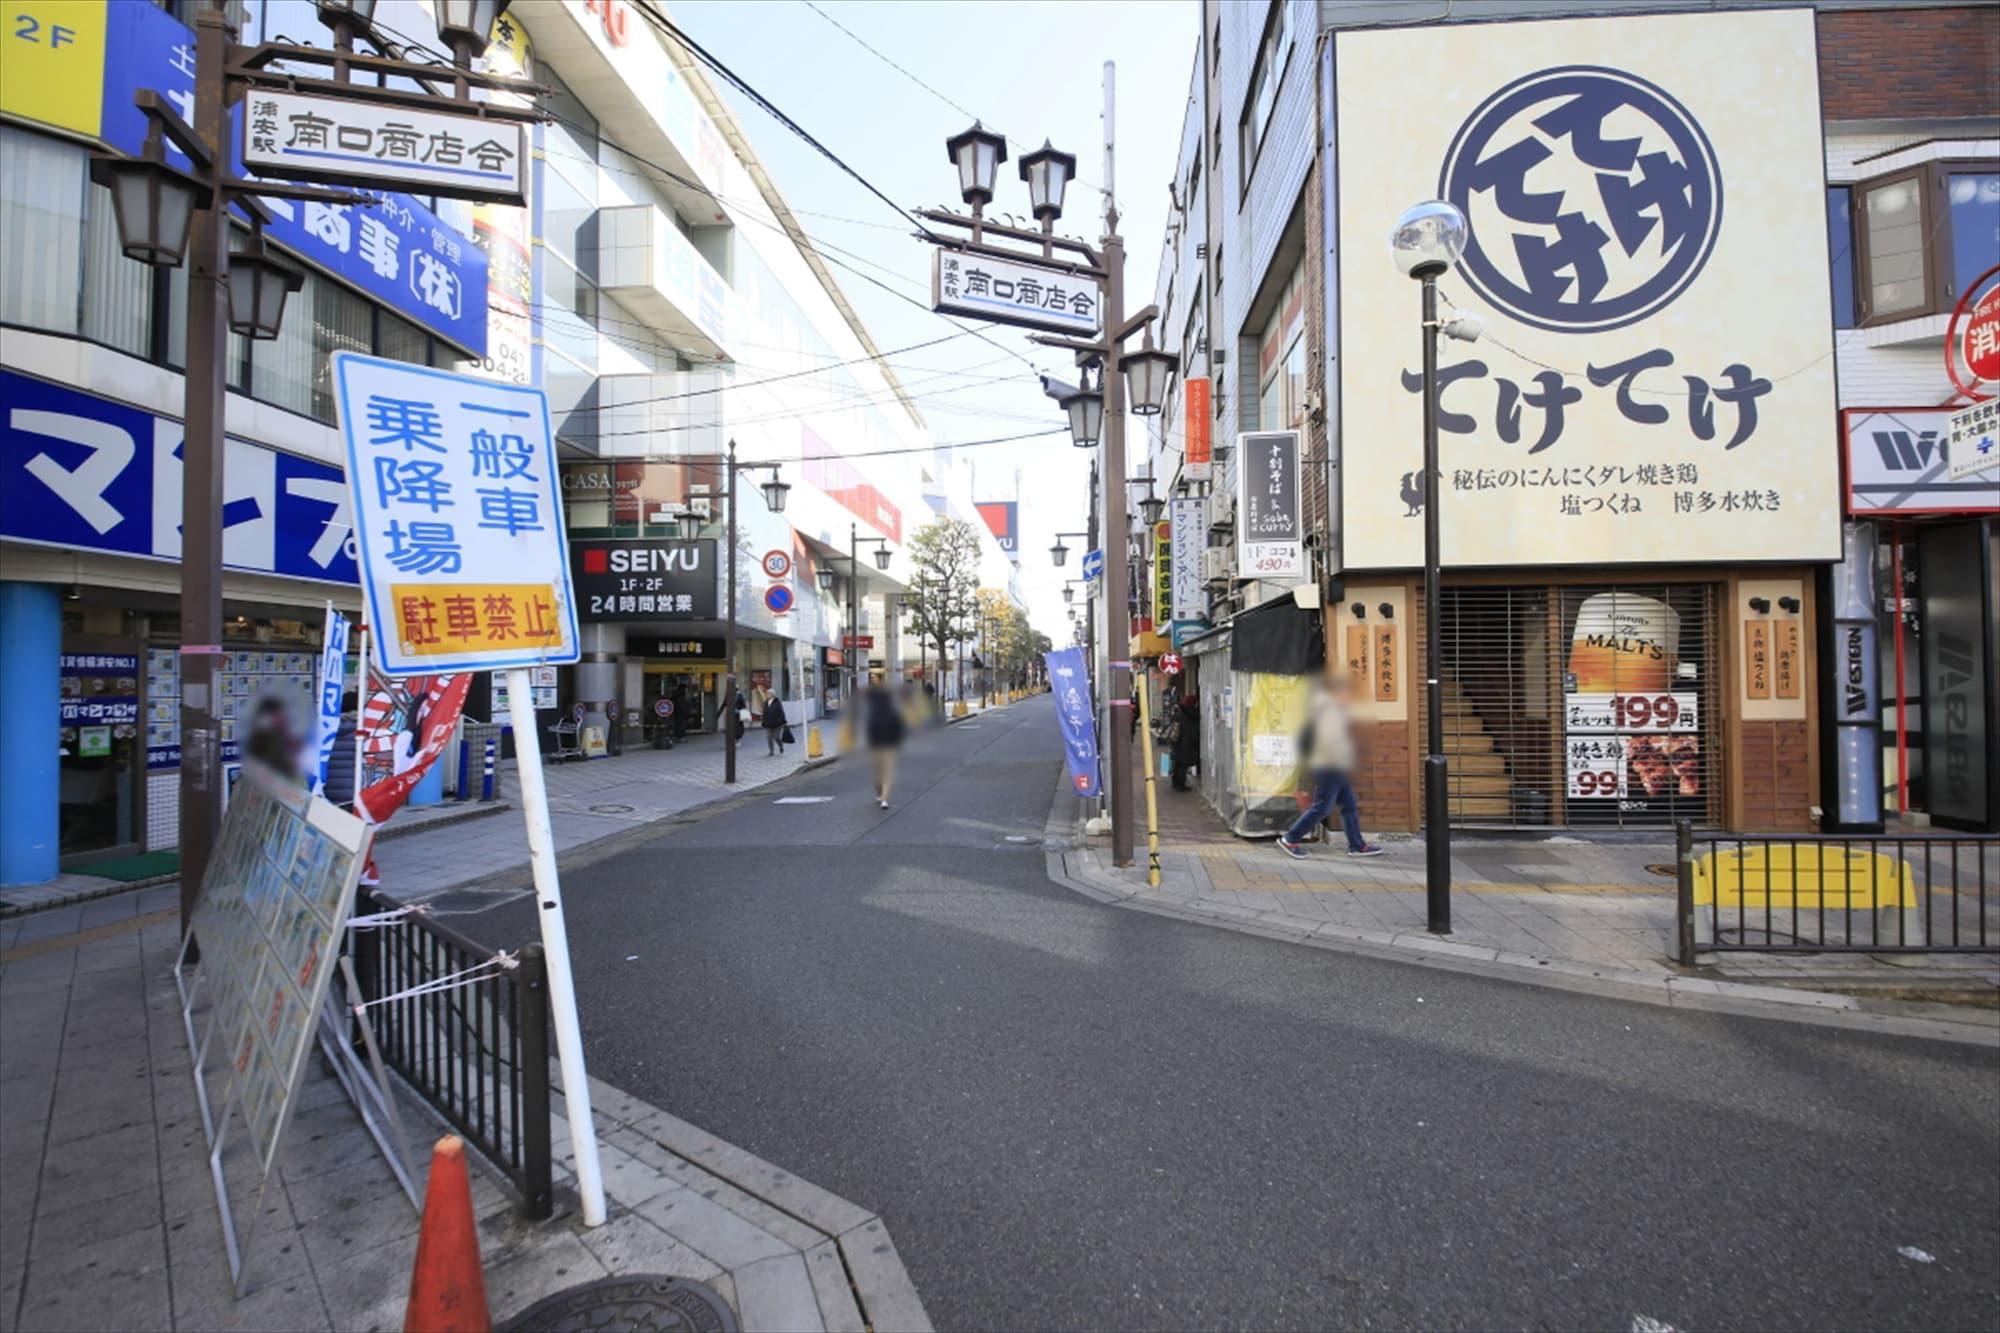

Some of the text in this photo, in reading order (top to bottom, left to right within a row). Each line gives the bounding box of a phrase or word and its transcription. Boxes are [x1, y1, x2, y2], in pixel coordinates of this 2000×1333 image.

[15, 15, 76, 49] 2F
[252, 100, 279, 154] 浦安駅
[284, 111, 514, 173] 南口商店会
[944, 257, 960, 299] 浦安駅
[963, 267, 1095, 316] 南口商店会
[1401, 349, 1773, 455] てけてけ
[366, 394, 464, 576] 乗降場
[460, 401, 546, 538] 一般車
[564, 471, 612, 490] CASA
[1452, 463, 1699, 491] 秘伝のにんにくダレ焼き鶏
[1559, 488, 1781, 516] 塩つくね 博多水炊き
[609, 548, 700, 572] SEIYU
[768, 556, 785, 572] 30
[401, 593, 556, 646] 駐車禁止
[591, 594, 693, 614] 24時間営業
[1585, 633, 1664, 660] MALT'S
